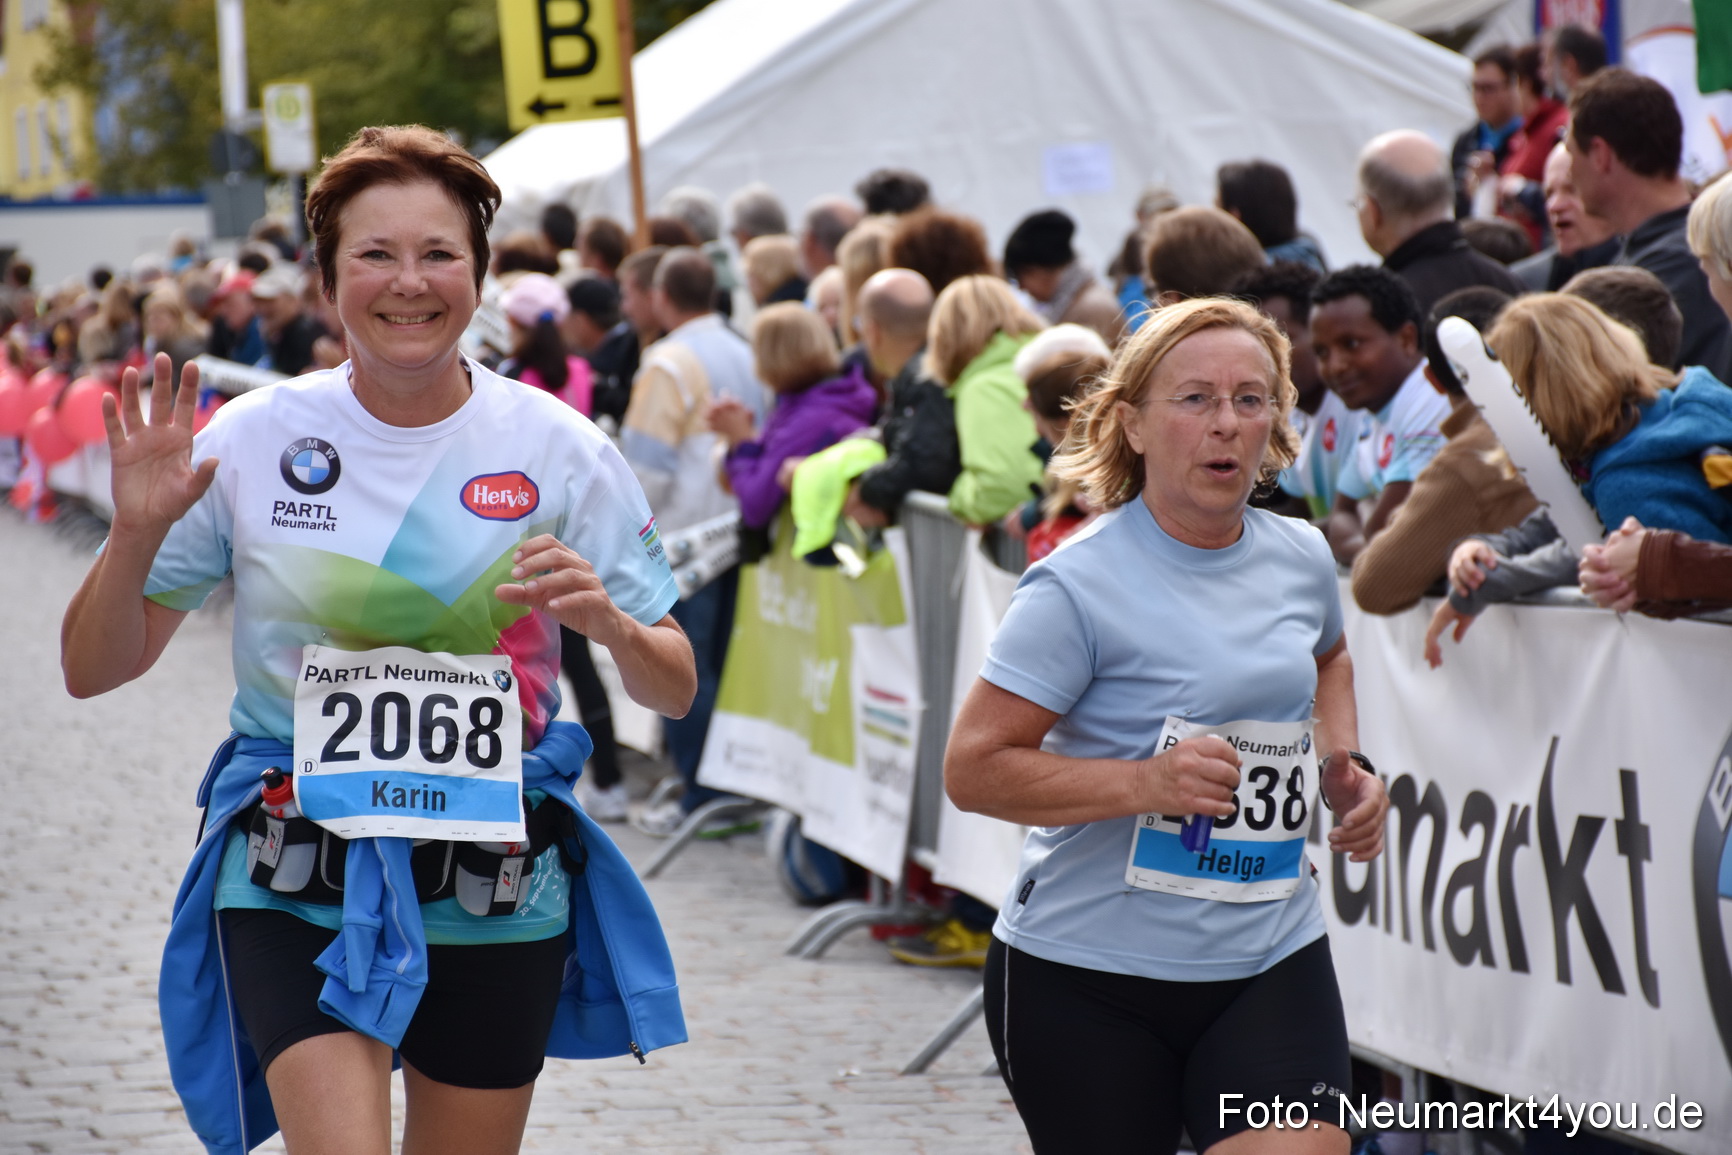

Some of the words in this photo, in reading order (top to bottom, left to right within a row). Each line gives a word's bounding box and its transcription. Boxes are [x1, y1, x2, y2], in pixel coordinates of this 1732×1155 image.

[538, 0, 598, 78] B
[287, 438, 337, 461] BMW
[473, 483, 529, 508] Hervis
[273, 500, 338, 521] PARTL
[271, 515, 336, 532] Neumarkt
[304, 664, 378, 684] PARTL
[384, 664, 490, 687] Neumarkt
[320, 691, 503, 769] 2068
[1227, 736, 1299, 757] Neumark
[304, 761, 313, 773] D
[371, 780, 447, 812] Karin
[1146, 815, 1155, 827] D
[1197, 848, 1265, 881] Helga
[529, 867, 553, 907] September
